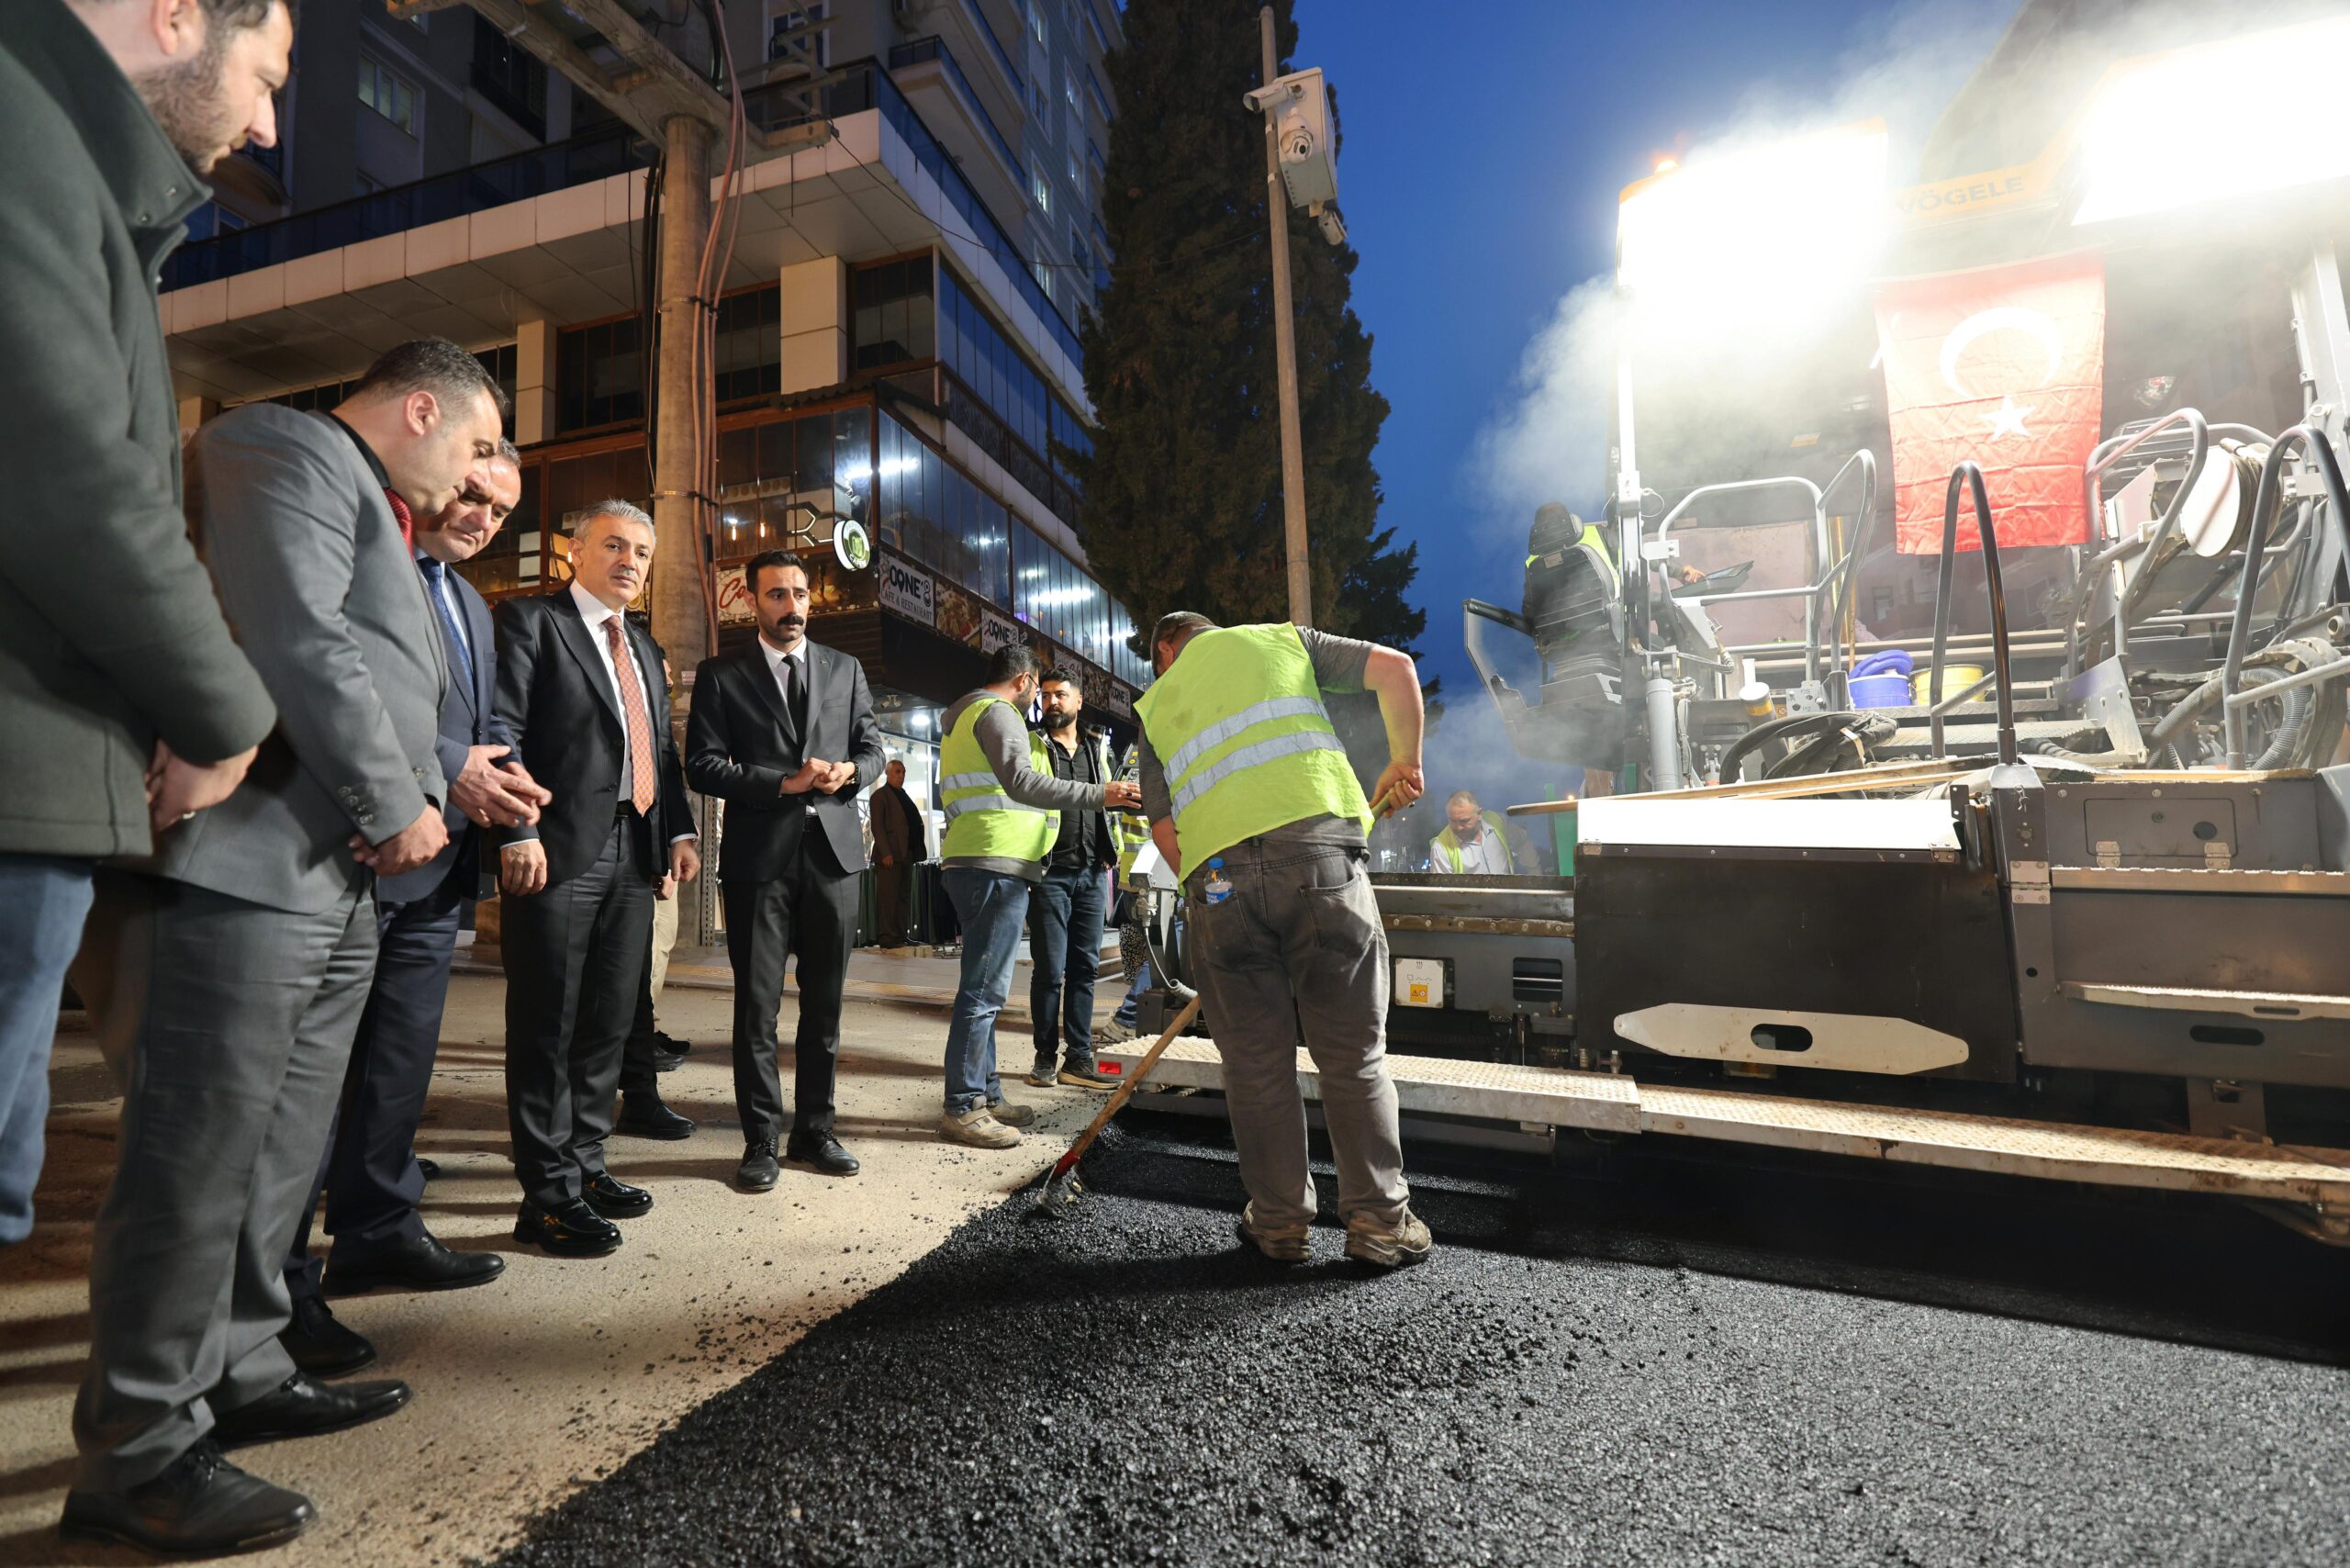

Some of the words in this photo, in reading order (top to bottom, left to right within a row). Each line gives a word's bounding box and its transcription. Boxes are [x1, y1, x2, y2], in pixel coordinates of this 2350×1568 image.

[1894, 175, 2026, 214] VÖGELE
[880, 588, 896, 604] CAFE
[901, 598, 933, 622] RESTAURANT
